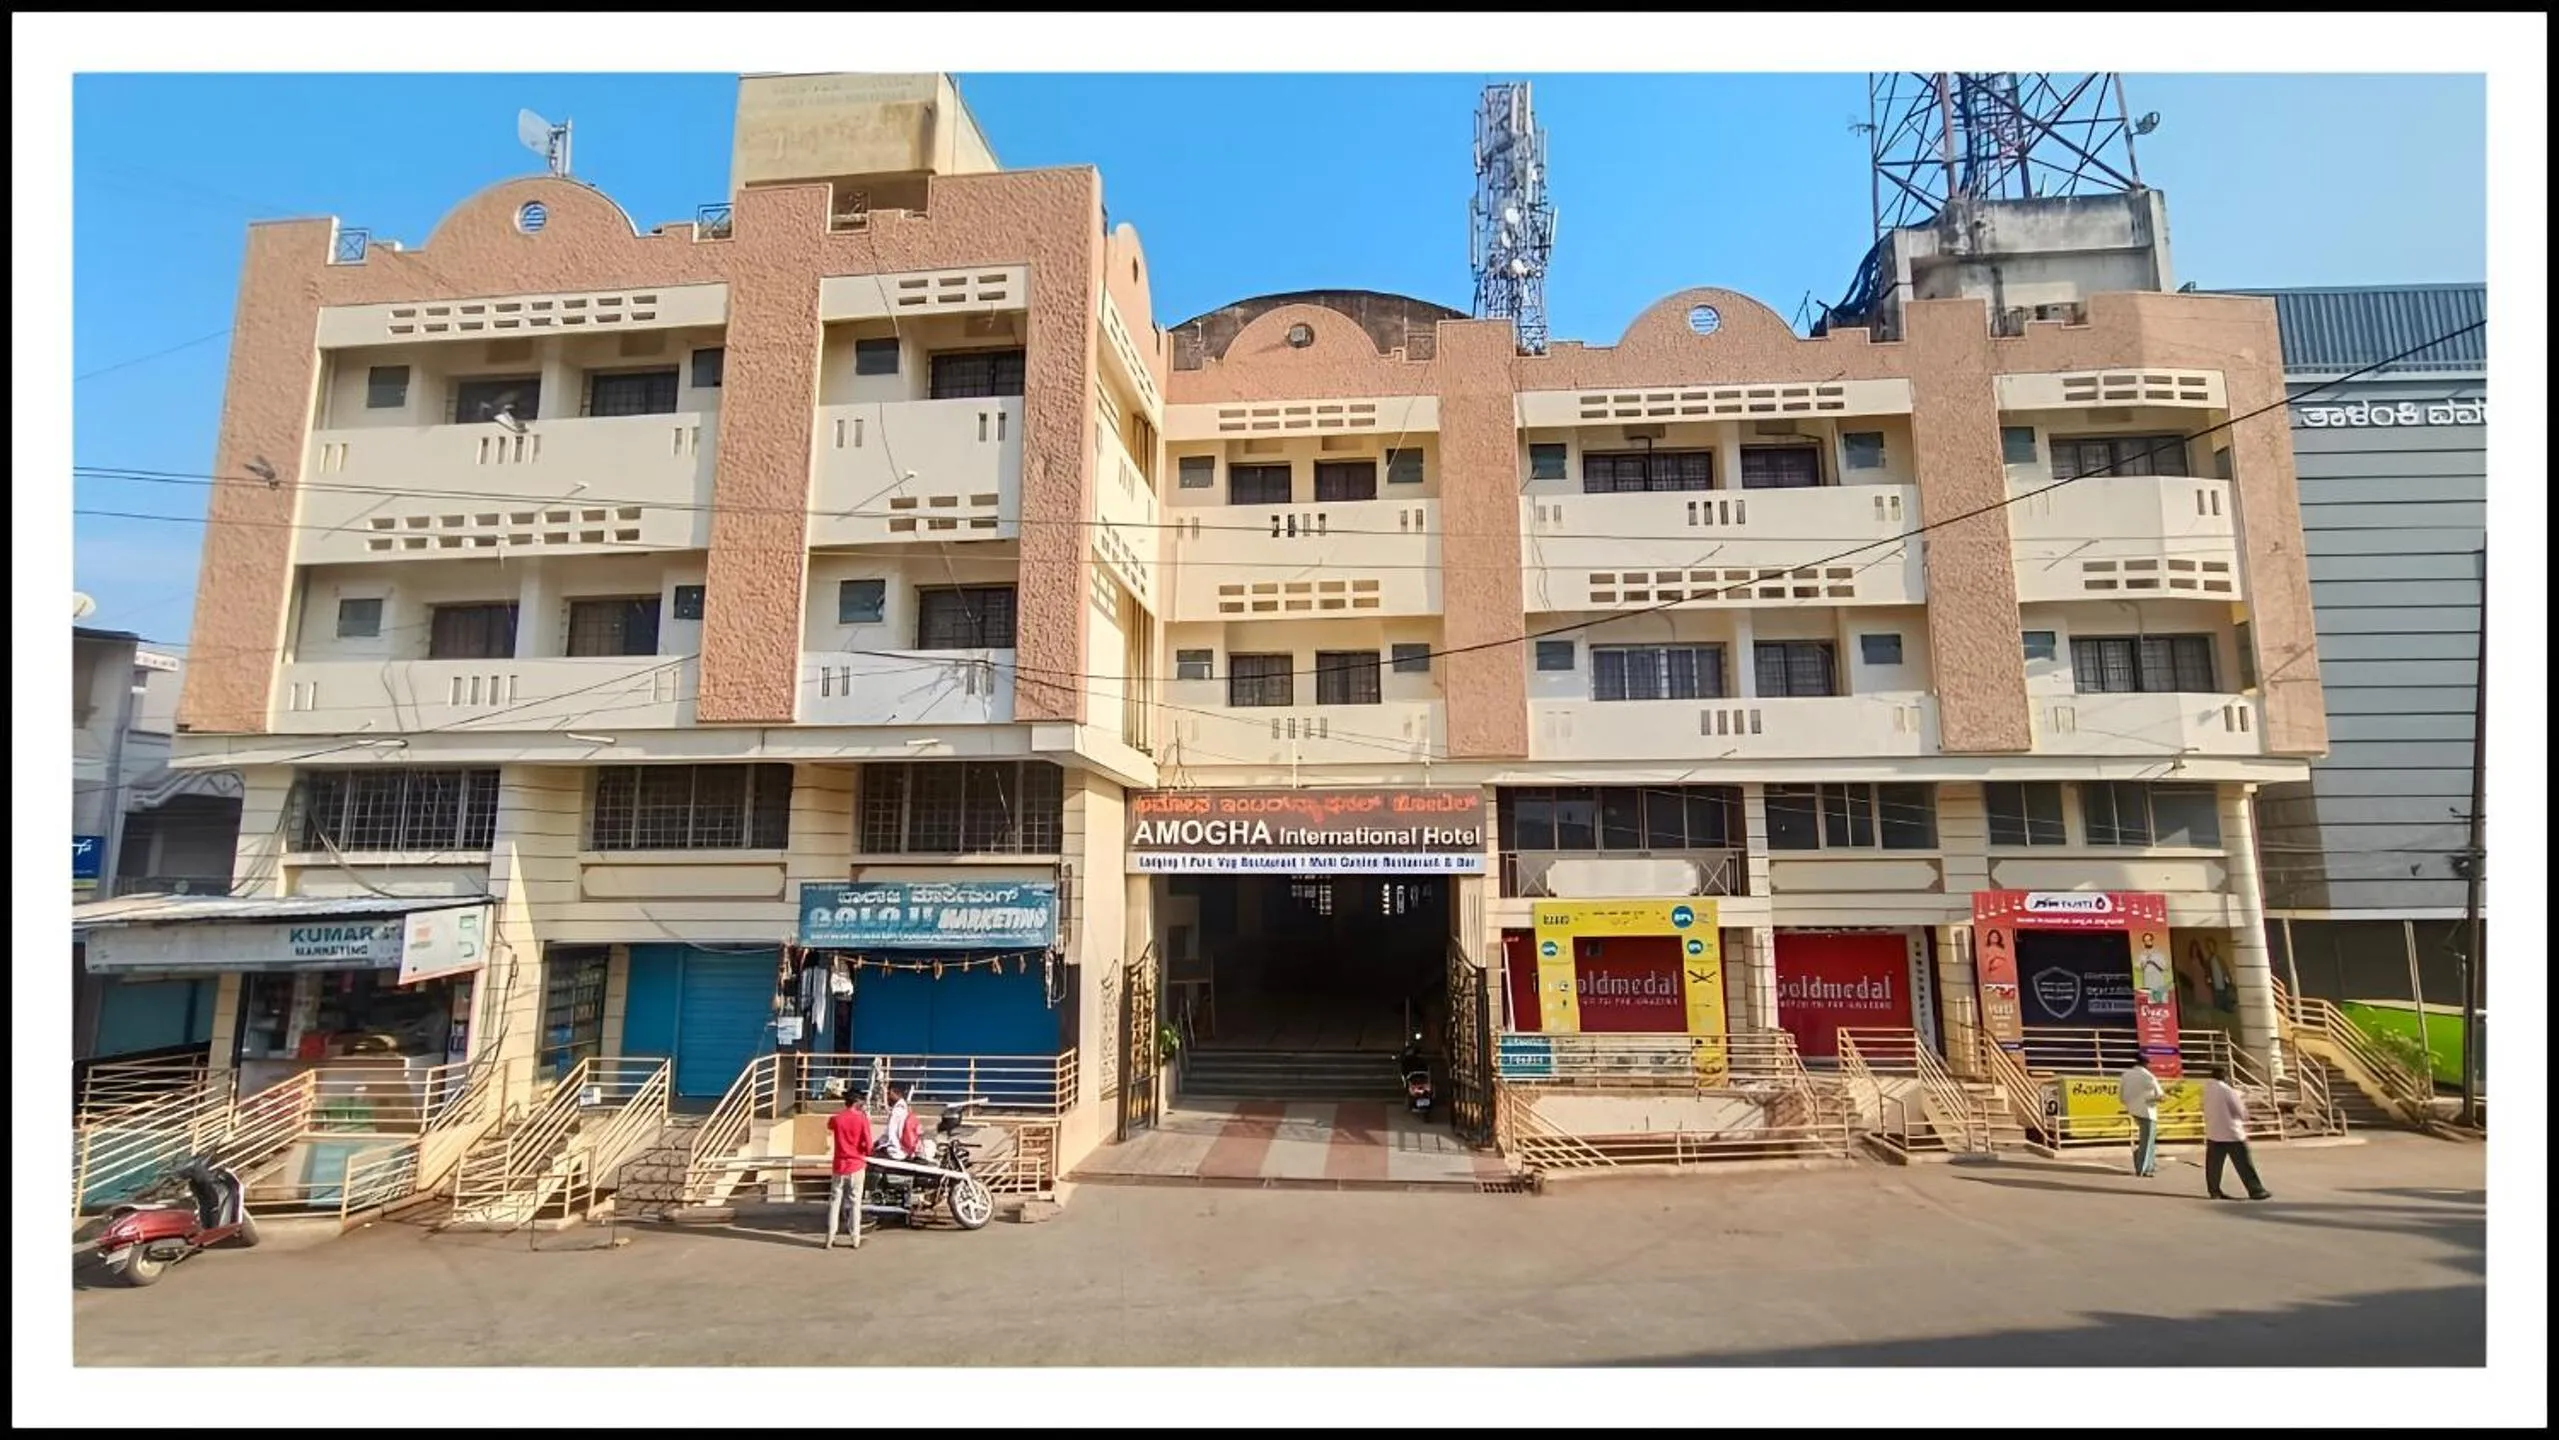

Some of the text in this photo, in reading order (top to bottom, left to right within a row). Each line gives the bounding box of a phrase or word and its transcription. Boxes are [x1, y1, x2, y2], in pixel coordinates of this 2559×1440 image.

[1132, 819, 1480, 846] AMOGHA International Hotel
[289, 926, 374, 943] KUMAR
[1577, 970, 1678, 995] oldmedal
